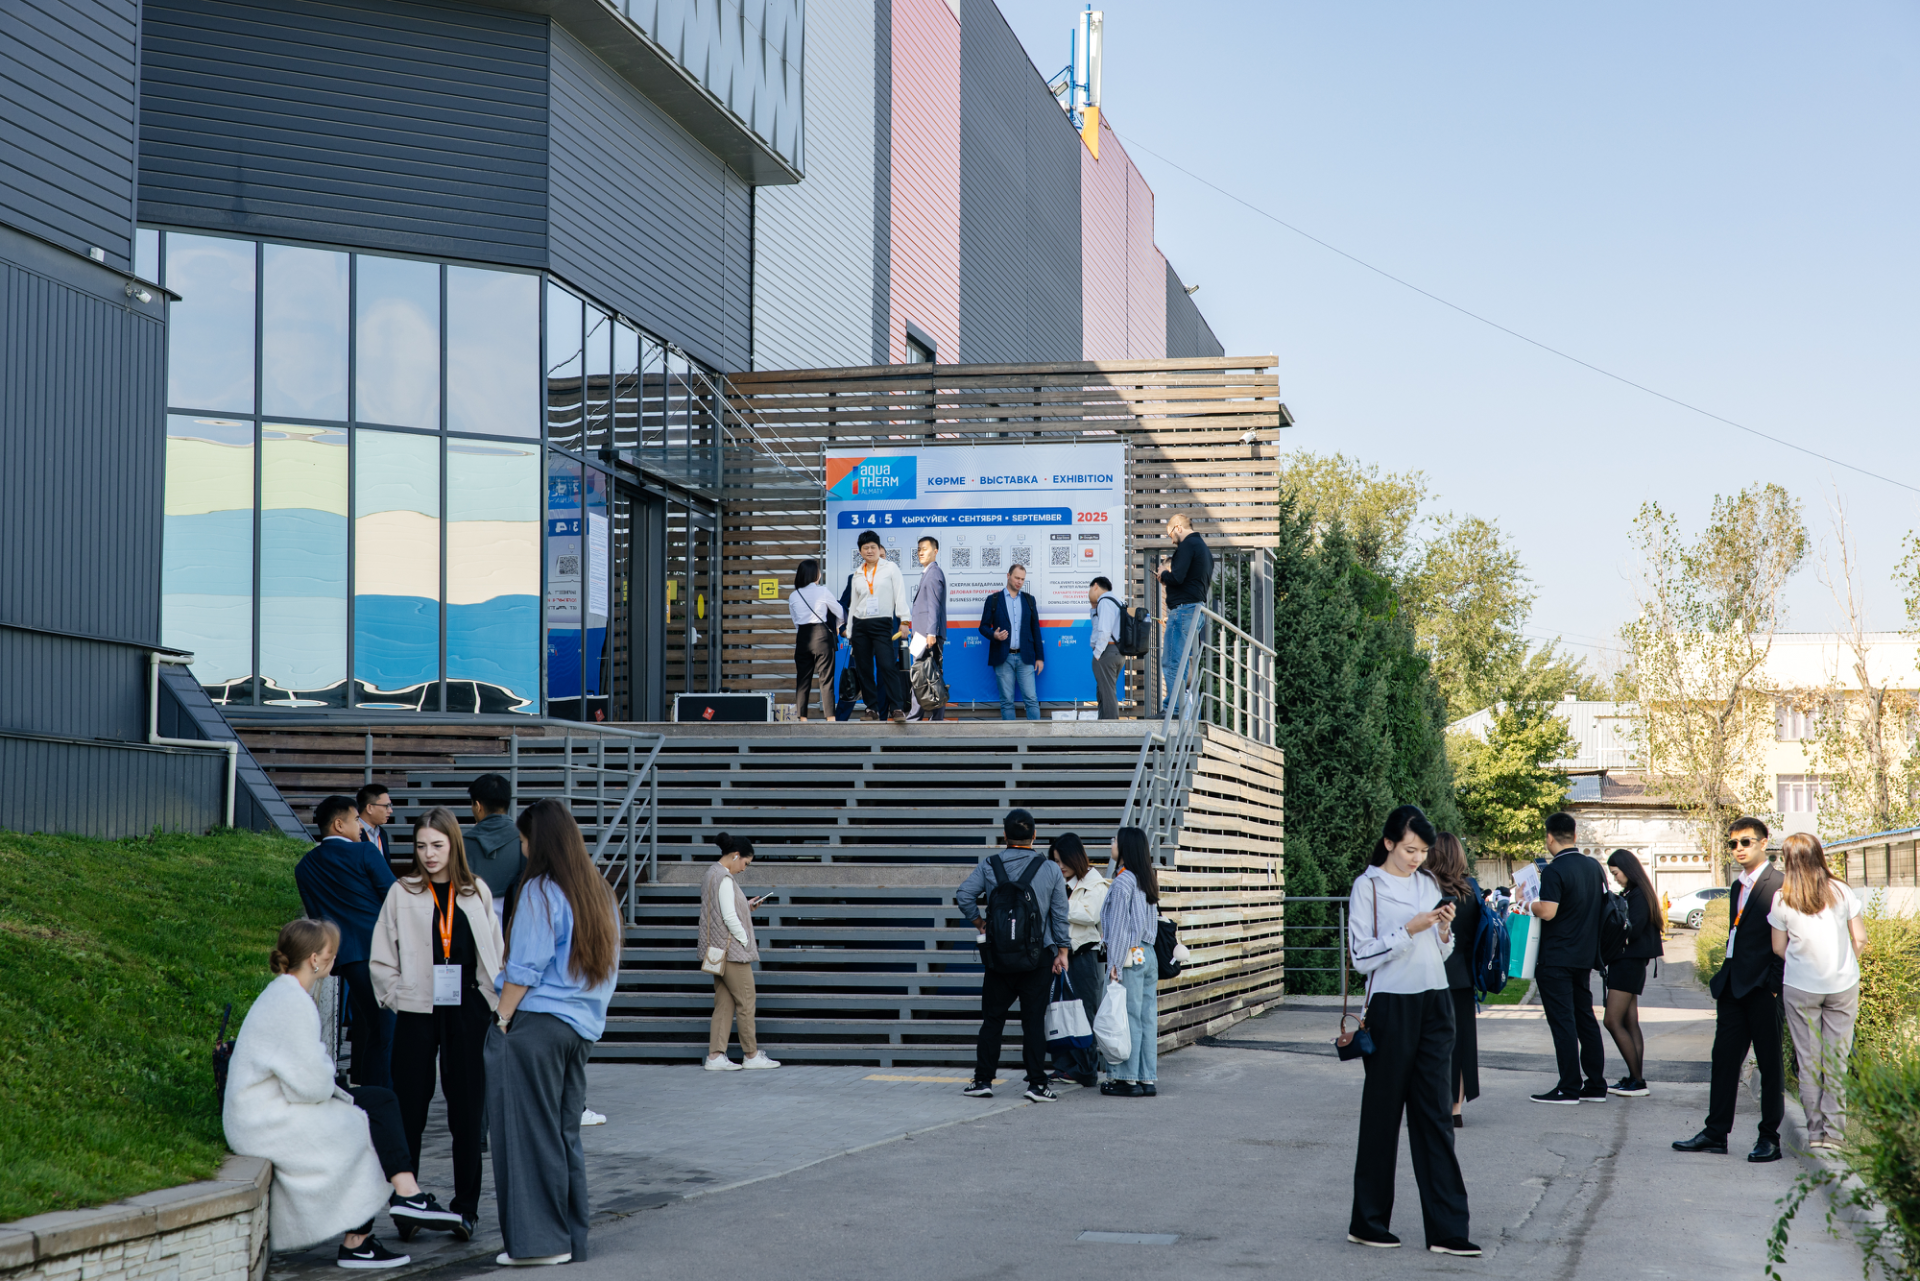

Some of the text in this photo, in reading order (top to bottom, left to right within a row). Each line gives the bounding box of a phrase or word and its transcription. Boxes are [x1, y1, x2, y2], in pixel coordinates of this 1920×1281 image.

[860, 465, 890, 478] aqua
[860, 476, 899, 488] THERM
[928, 474, 1114, 486] КӨРМЕ ВЫСТАВКА EXHIBITION
[851, 511, 1108, 525] 3 4 5 ҚЫРКҮЙЕК СЕНТЯБРЯ SEPTEMBER 2025
